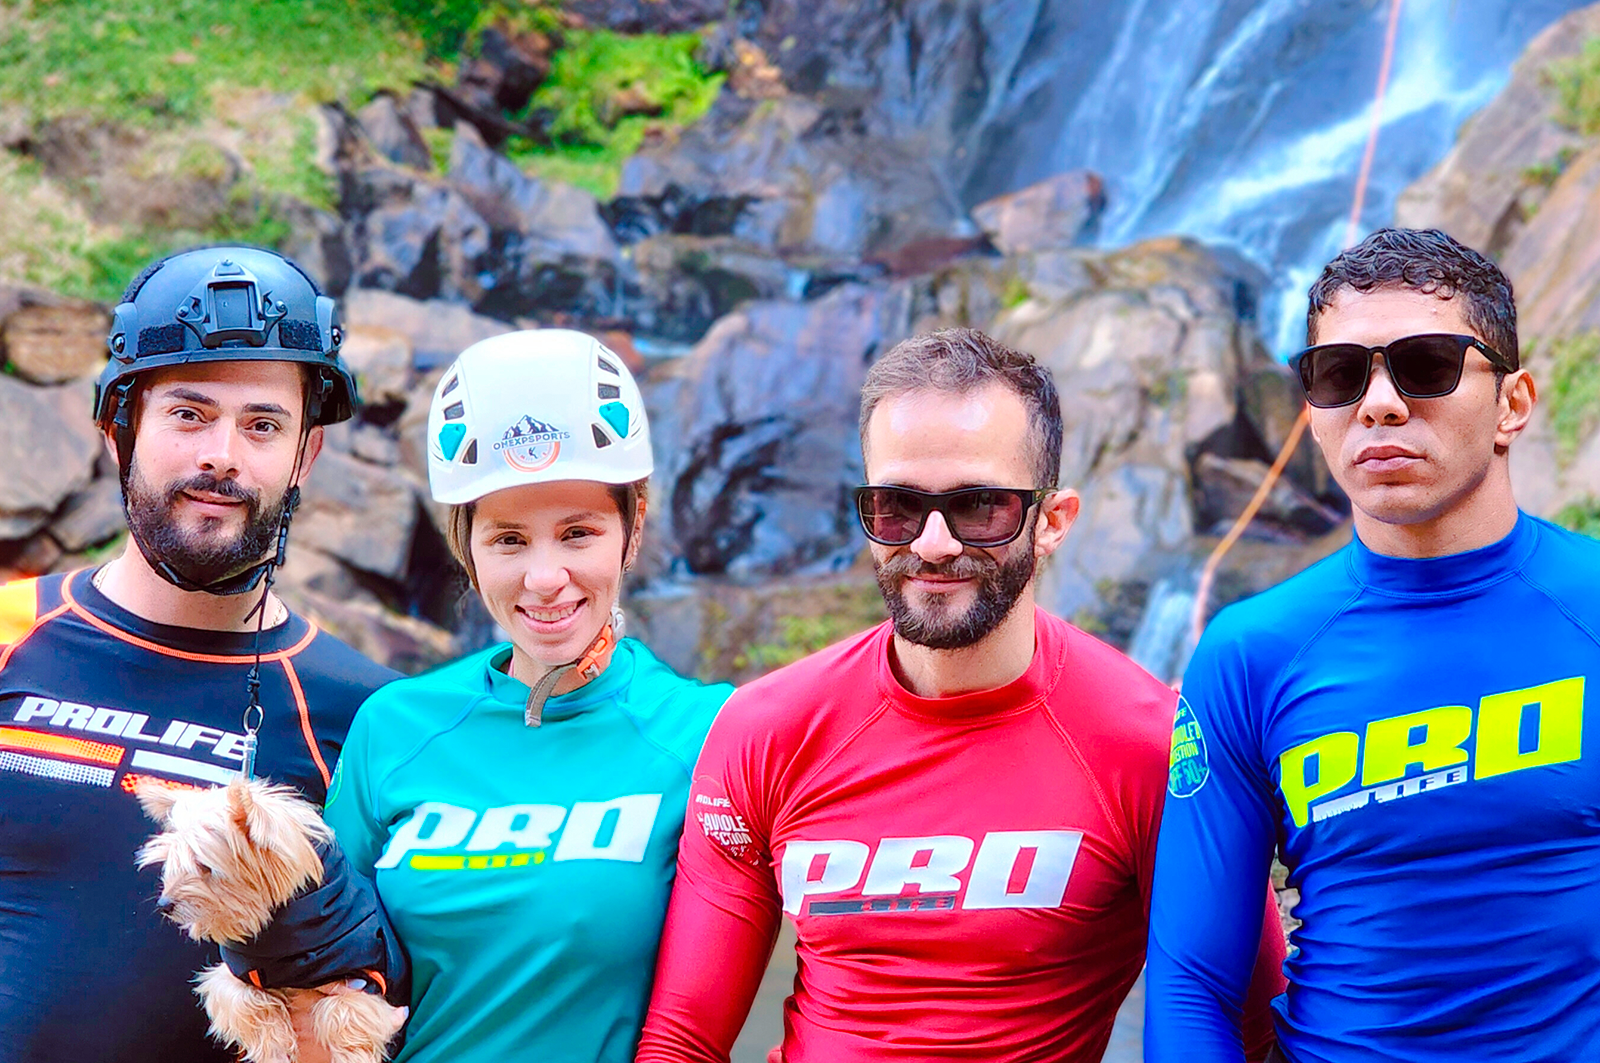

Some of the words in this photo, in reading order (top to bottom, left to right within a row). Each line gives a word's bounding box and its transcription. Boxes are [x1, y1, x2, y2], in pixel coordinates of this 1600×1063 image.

[13, 696, 247, 761] PROLIFE
[1279, 676, 1585, 828] PRO
[1368, 767, 1461, 804] LIFE
[374, 793, 664, 869] PRO
[782, 831, 1084, 916] PRO
